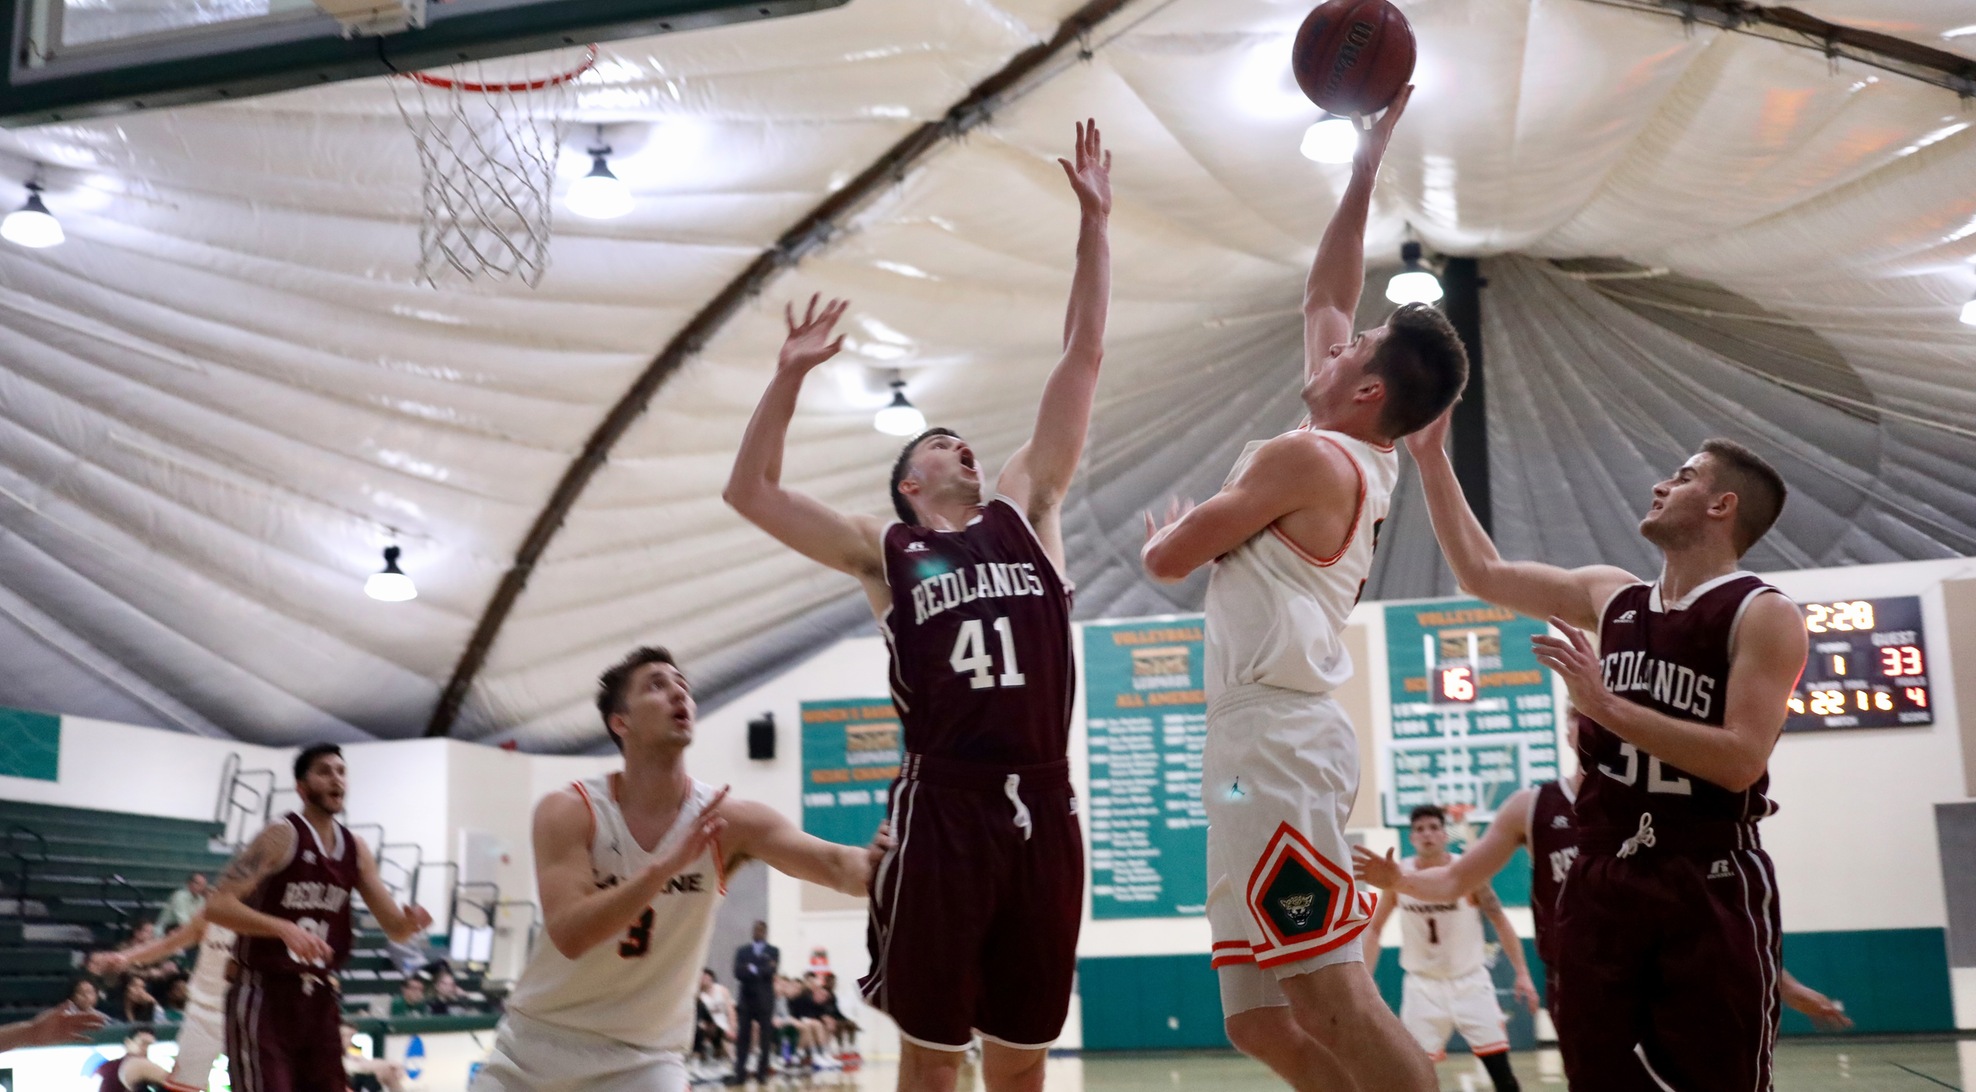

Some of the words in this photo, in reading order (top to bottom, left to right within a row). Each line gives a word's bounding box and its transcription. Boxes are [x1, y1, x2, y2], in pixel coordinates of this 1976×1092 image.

[911, 562, 1044, 626] REDLANDS
[1806, 600, 1875, 633] 2:28
[949, 616, 1026, 689] 41
[1871, 631, 1916, 647] GUEST
[1833, 654, 1846, 675] 1
[1881, 646, 1923, 676] 33
[1442, 666, 1475, 701] 16
[1810, 690, 1845, 715] 22
[1857, 690, 1869, 711] 1
[1874, 691, 1893, 711] 6
[1905, 687, 1927, 708] 4
[618, 904, 655, 959] 3
[1427, 918, 1440, 945] 1
